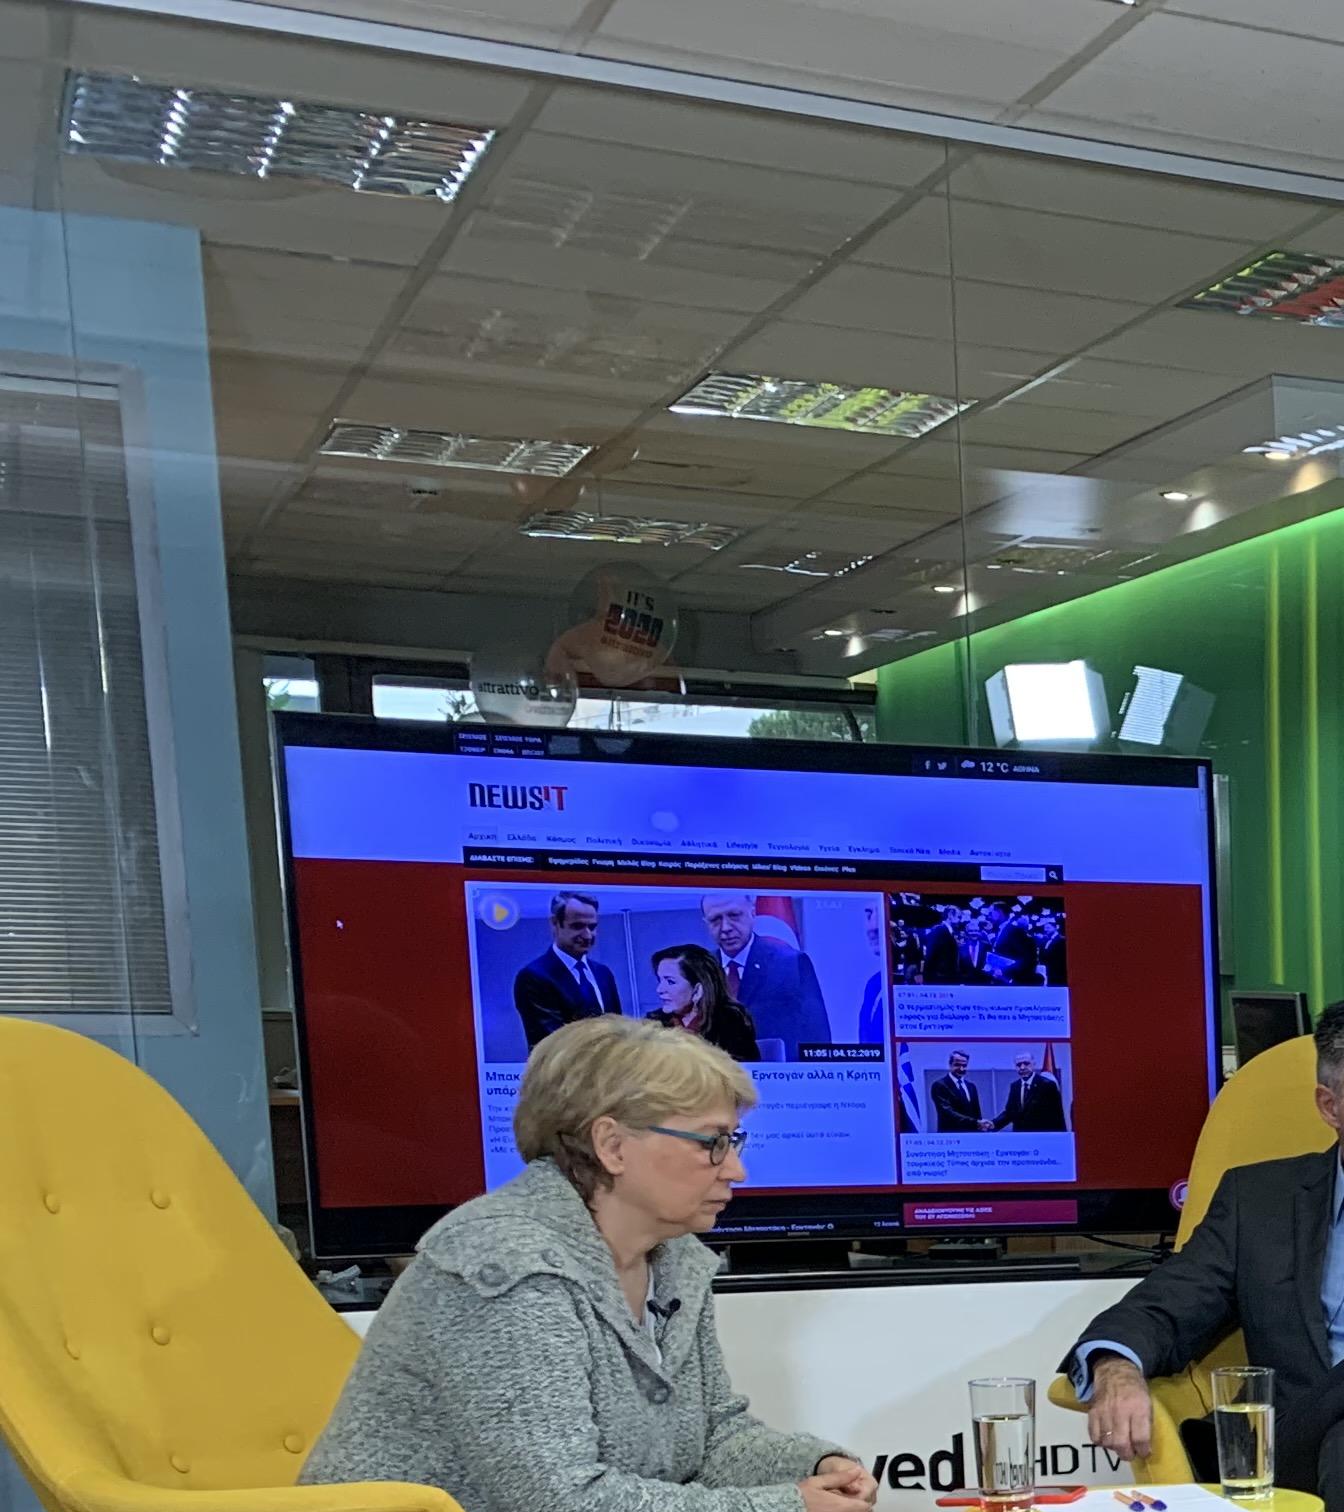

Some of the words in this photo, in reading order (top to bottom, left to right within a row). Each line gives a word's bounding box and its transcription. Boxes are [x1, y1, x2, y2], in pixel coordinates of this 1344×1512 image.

[603, 603, 664, 648] 2020
[477, 682, 540, 696] attrattivo
[980, 761, 995, 773] 12
[468, 782, 569, 811] NEWSIT
[803, 1049, 828, 1058] 11:05
[832, 1049, 881, 1058] 04.12.2019
[485, 1071, 520, 1081] Μπακ
[751, 1069, 805, 1082] Ερντογάν
[807, 1069, 834, 1080] αλλά
[837, 1071, 844, 1082] η
[846, 1069, 881, 1081] Κρήτη
[486, 1085, 517, 1097] υπάρ
